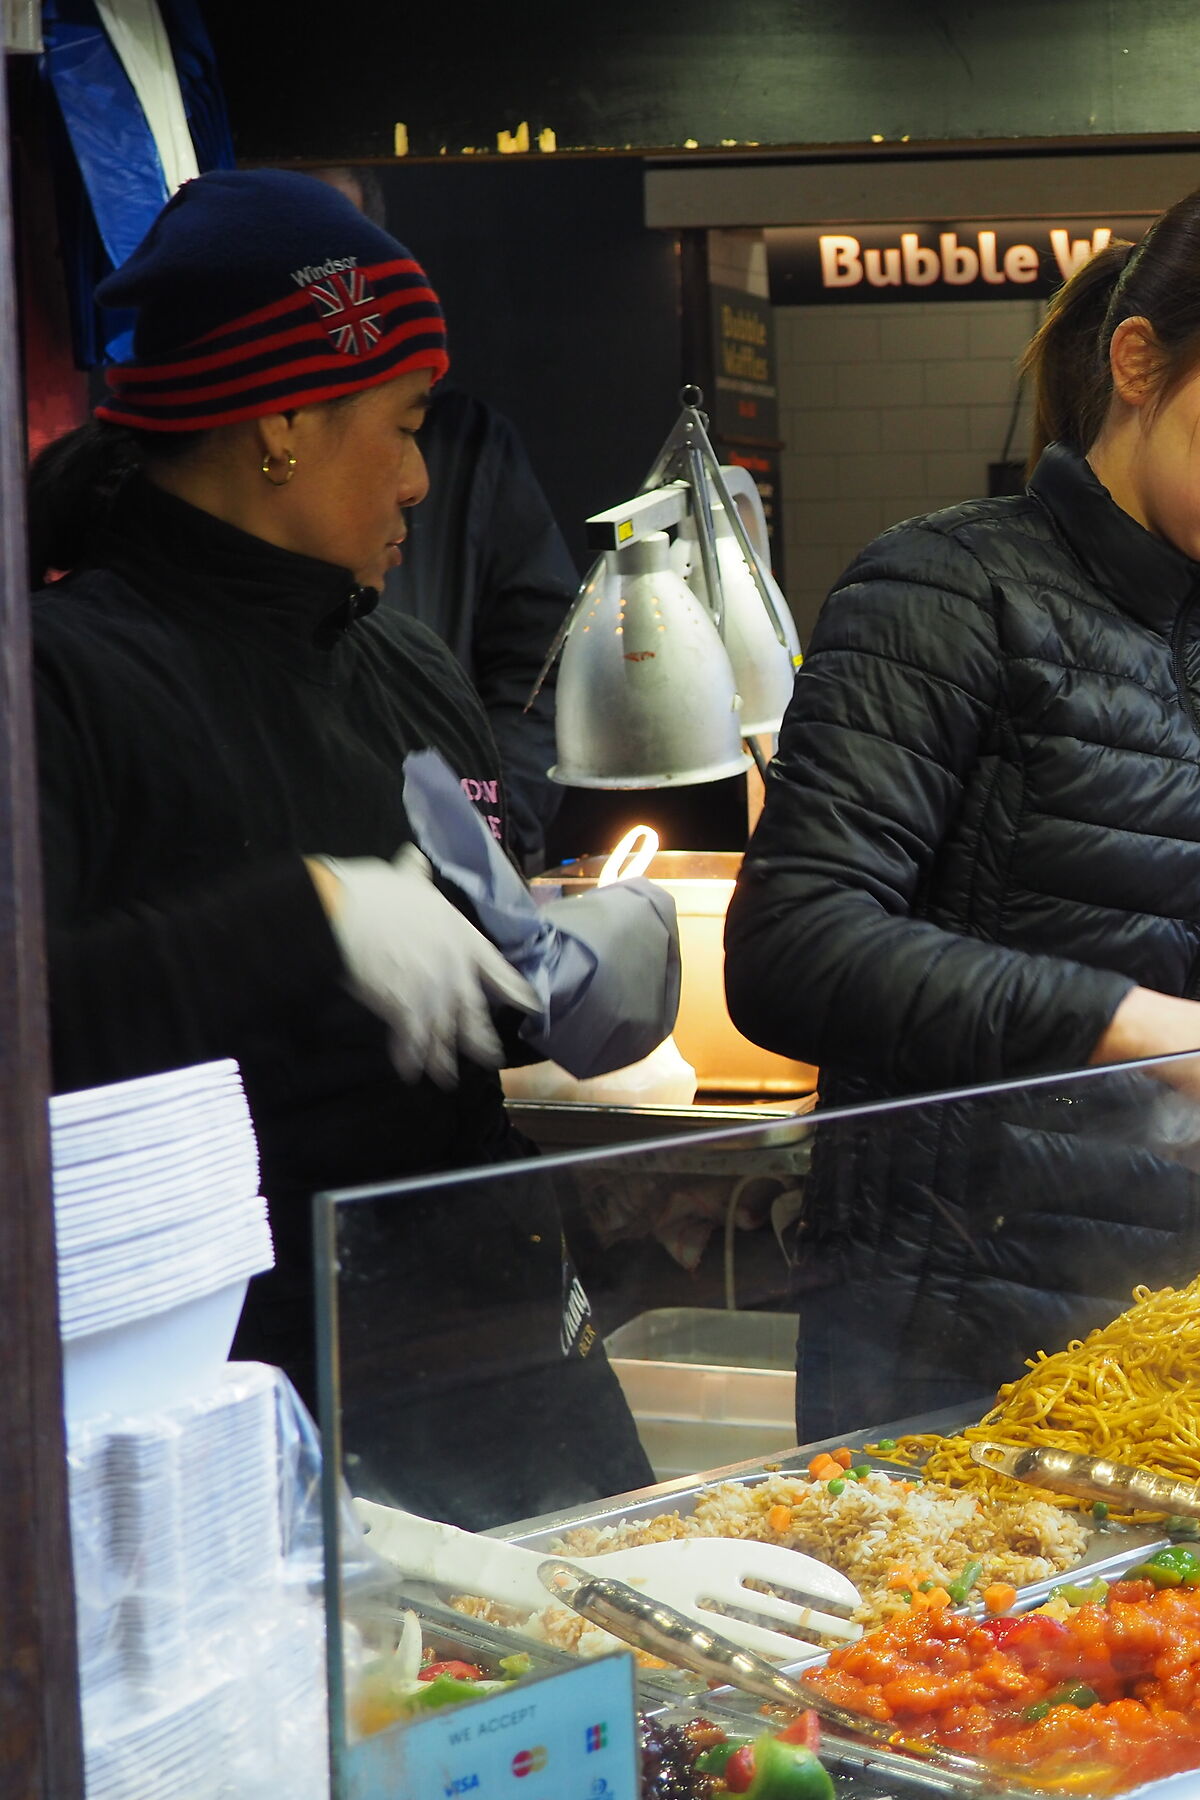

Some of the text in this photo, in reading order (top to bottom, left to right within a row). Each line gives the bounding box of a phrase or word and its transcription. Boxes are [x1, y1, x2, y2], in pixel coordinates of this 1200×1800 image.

[290, 256, 357, 288] Windsor
[819, 231, 1038, 288] Bubble
[449, 1704, 538, 1746] WE ACCEPT
[444, 1774, 480, 1797] VISA
